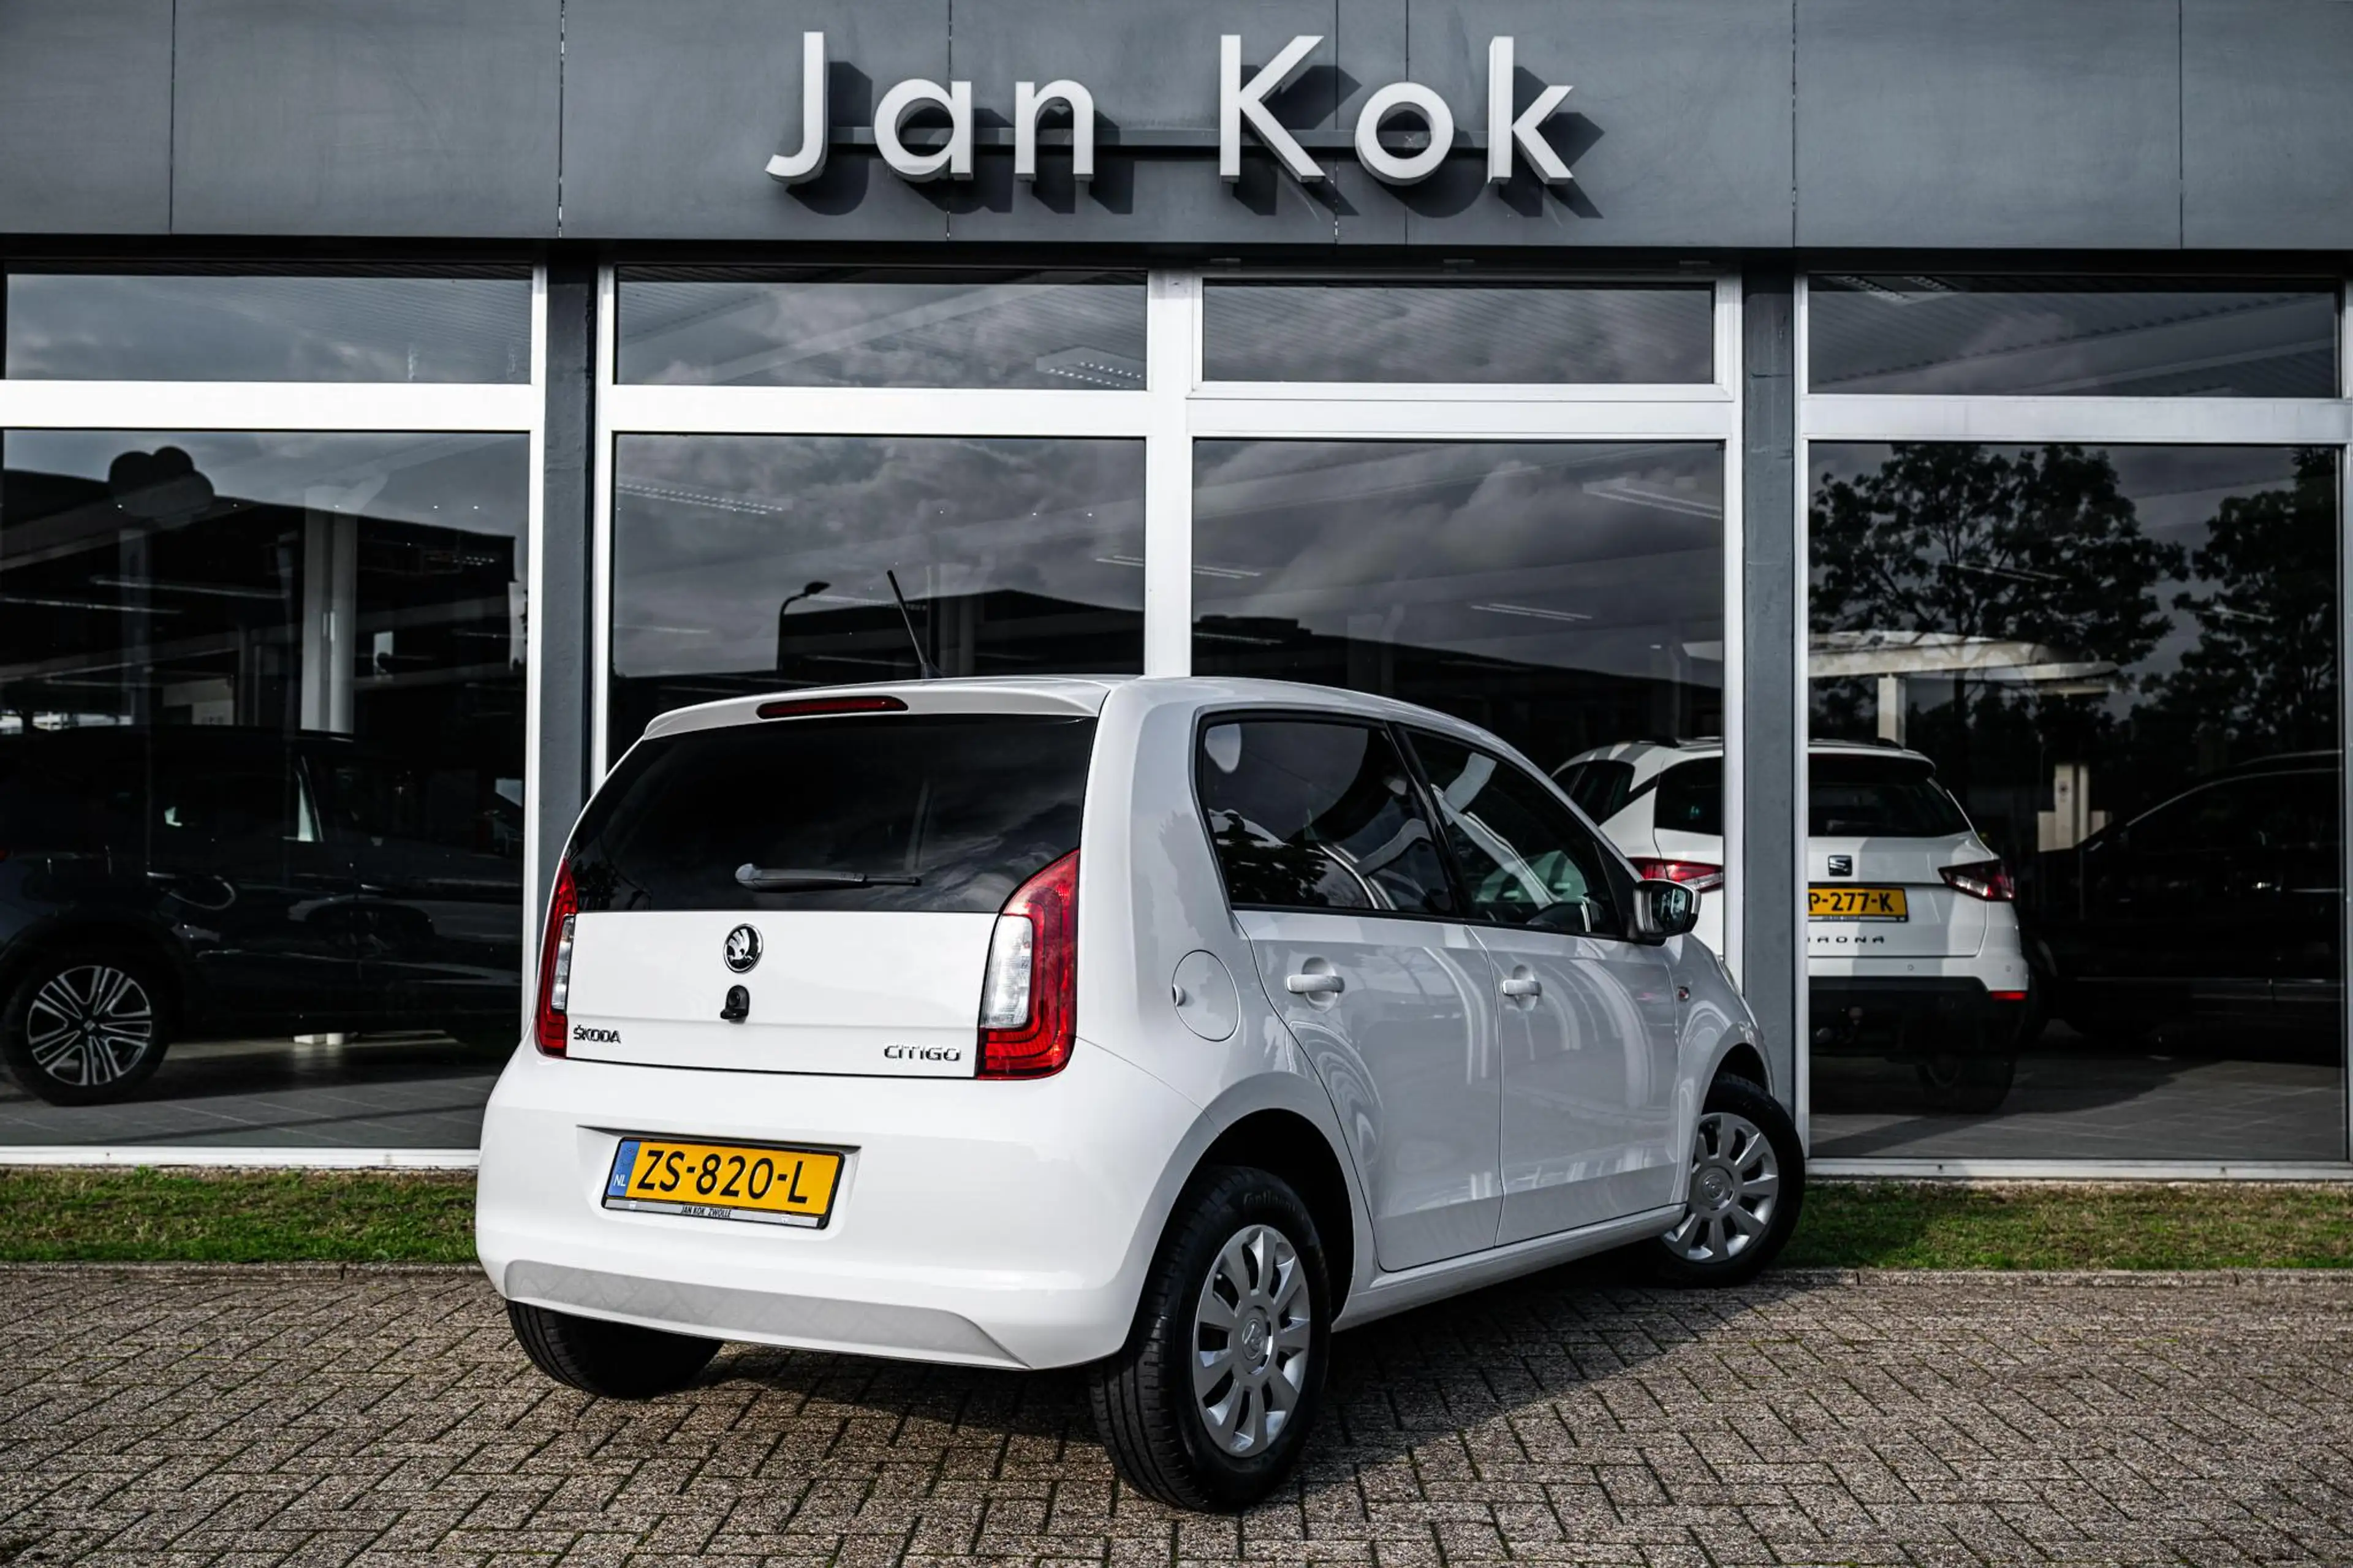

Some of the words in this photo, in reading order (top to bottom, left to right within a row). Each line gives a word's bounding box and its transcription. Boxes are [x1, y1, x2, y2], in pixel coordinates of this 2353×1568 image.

[765, 31, 1094, 183] Jan
[1219, 34, 1574, 185] Kok
[1808, 936, 1885, 944] RONA
[573, 1025, 621, 1043] ŠKODA
[884, 1044, 961, 1061] CITIGO
[613, 1173, 626, 1187] NL
[637, 1149, 808, 1204] ZS-820-L
[680, 1205, 692, 1214] JAN
[692, 1206, 705, 1216] KOK
